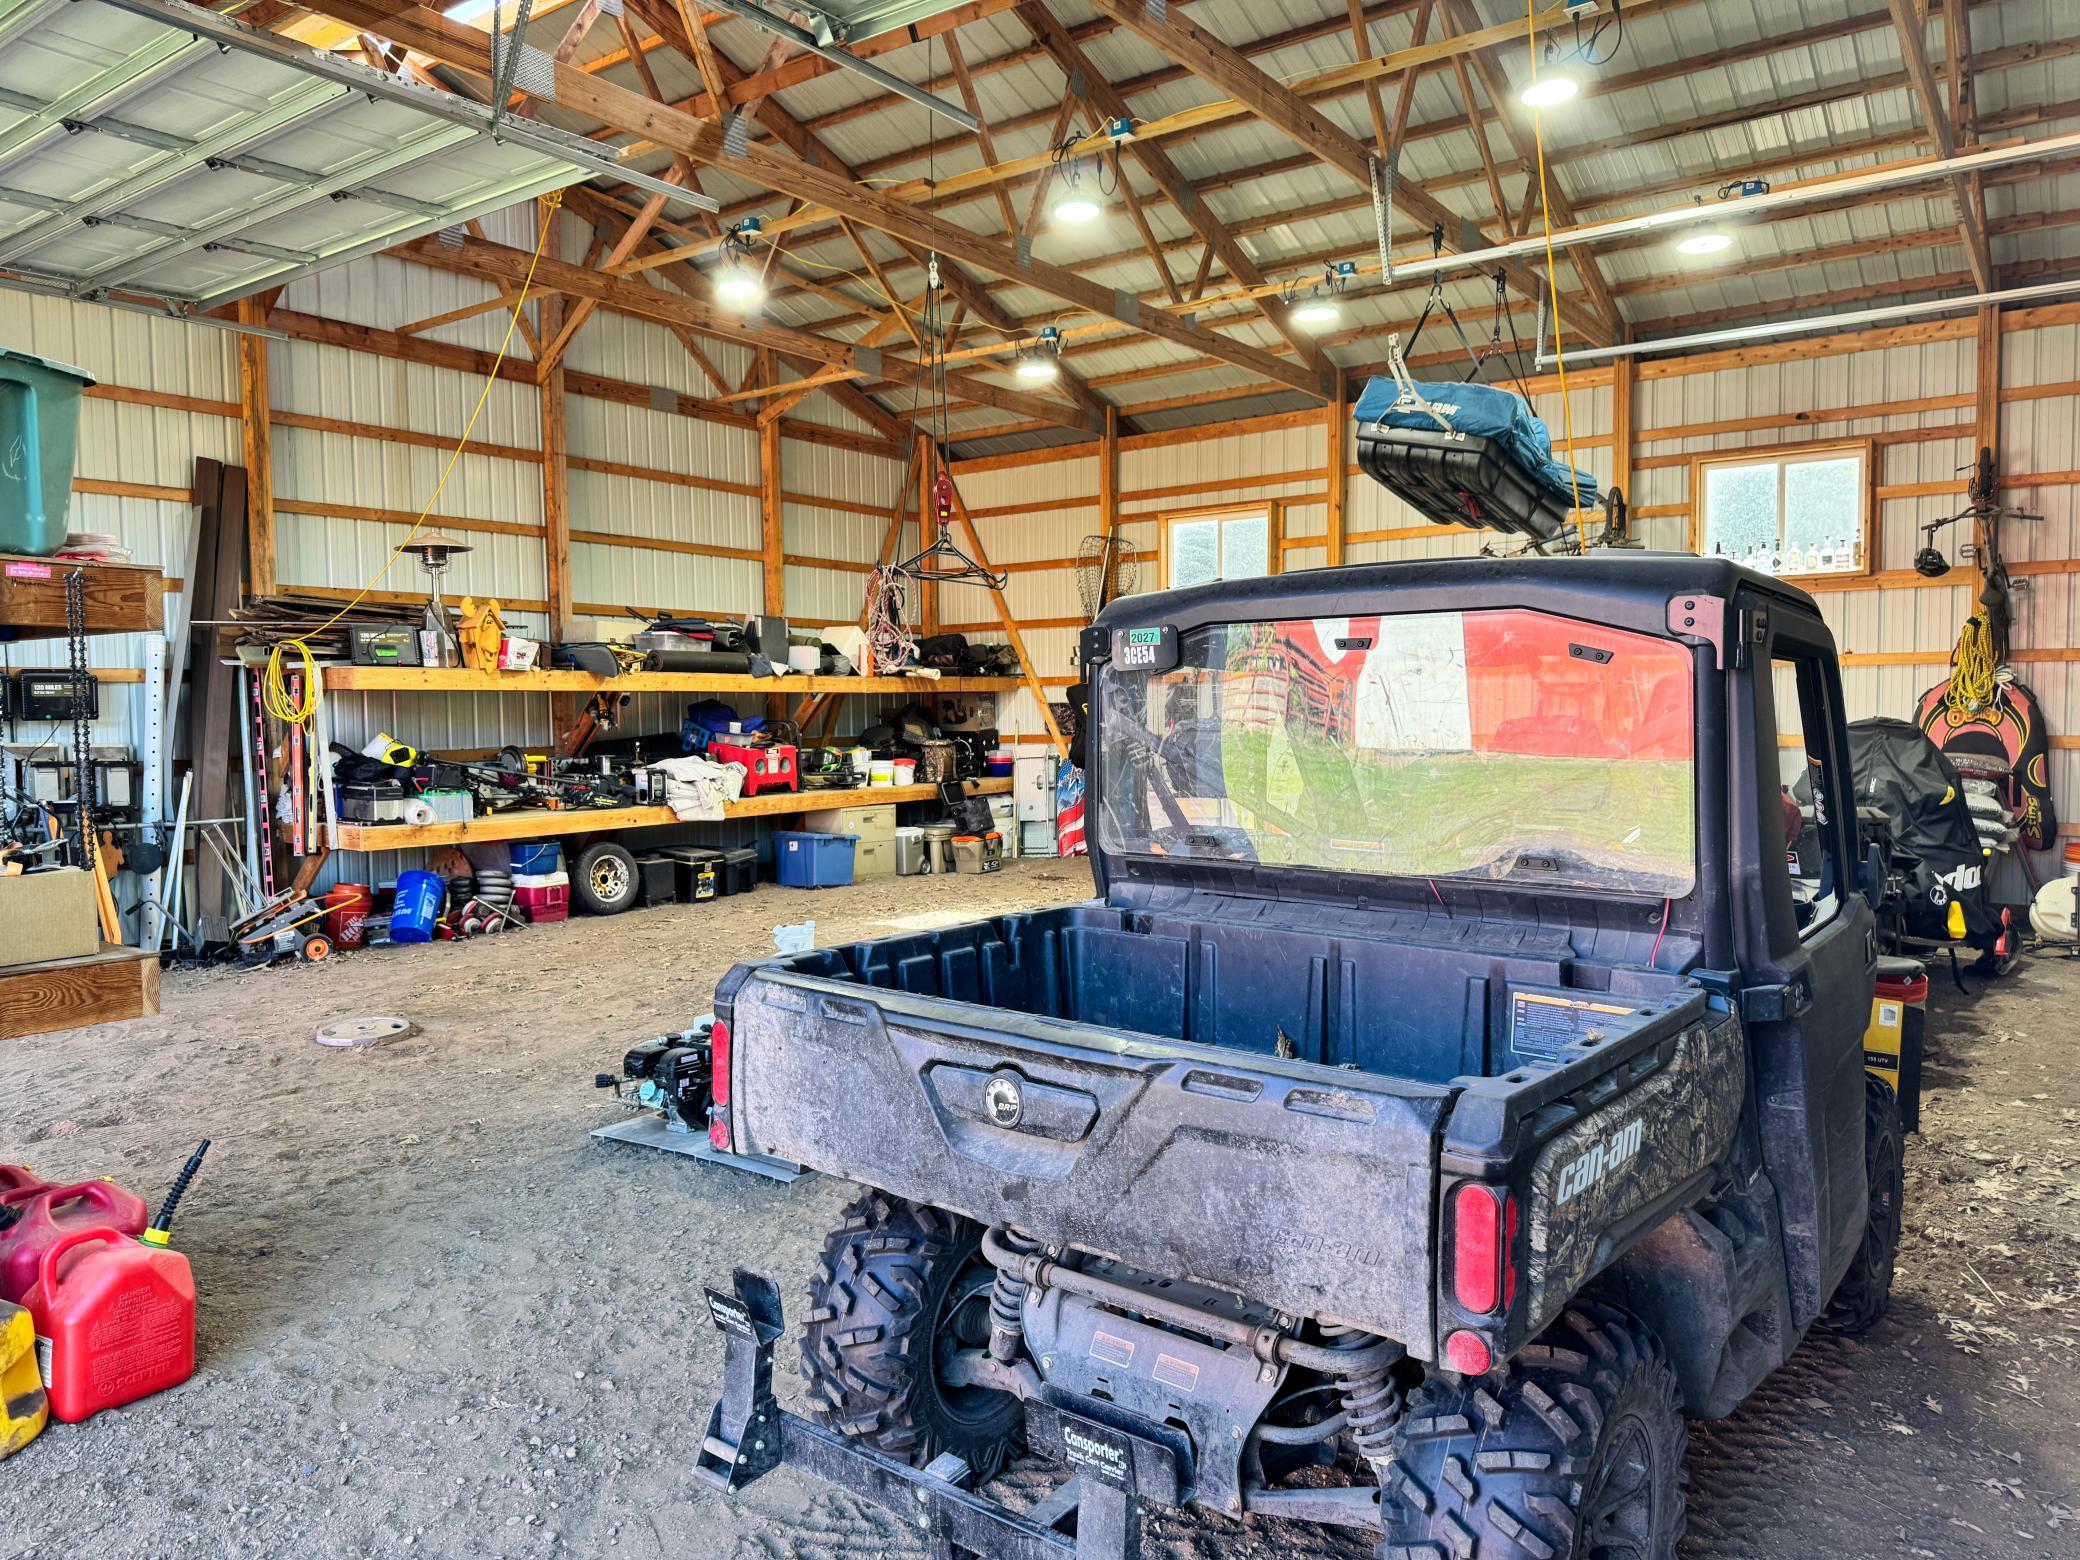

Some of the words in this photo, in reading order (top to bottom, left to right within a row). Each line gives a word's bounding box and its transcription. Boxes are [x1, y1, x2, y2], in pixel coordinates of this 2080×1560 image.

[1131, 632, 1155, 643] 2027
[998, 1102, 1018, 1112] BRP
[1557, 1118, 1642, 1206] can-am
[1064, 1426, 1119, 1463] Cansporter
[1066, 1447, 1085, 1461] Trash
[1085, 1455, 1100, 1467] Cart
[1100, 1461, 1124, 1477] Carrier
